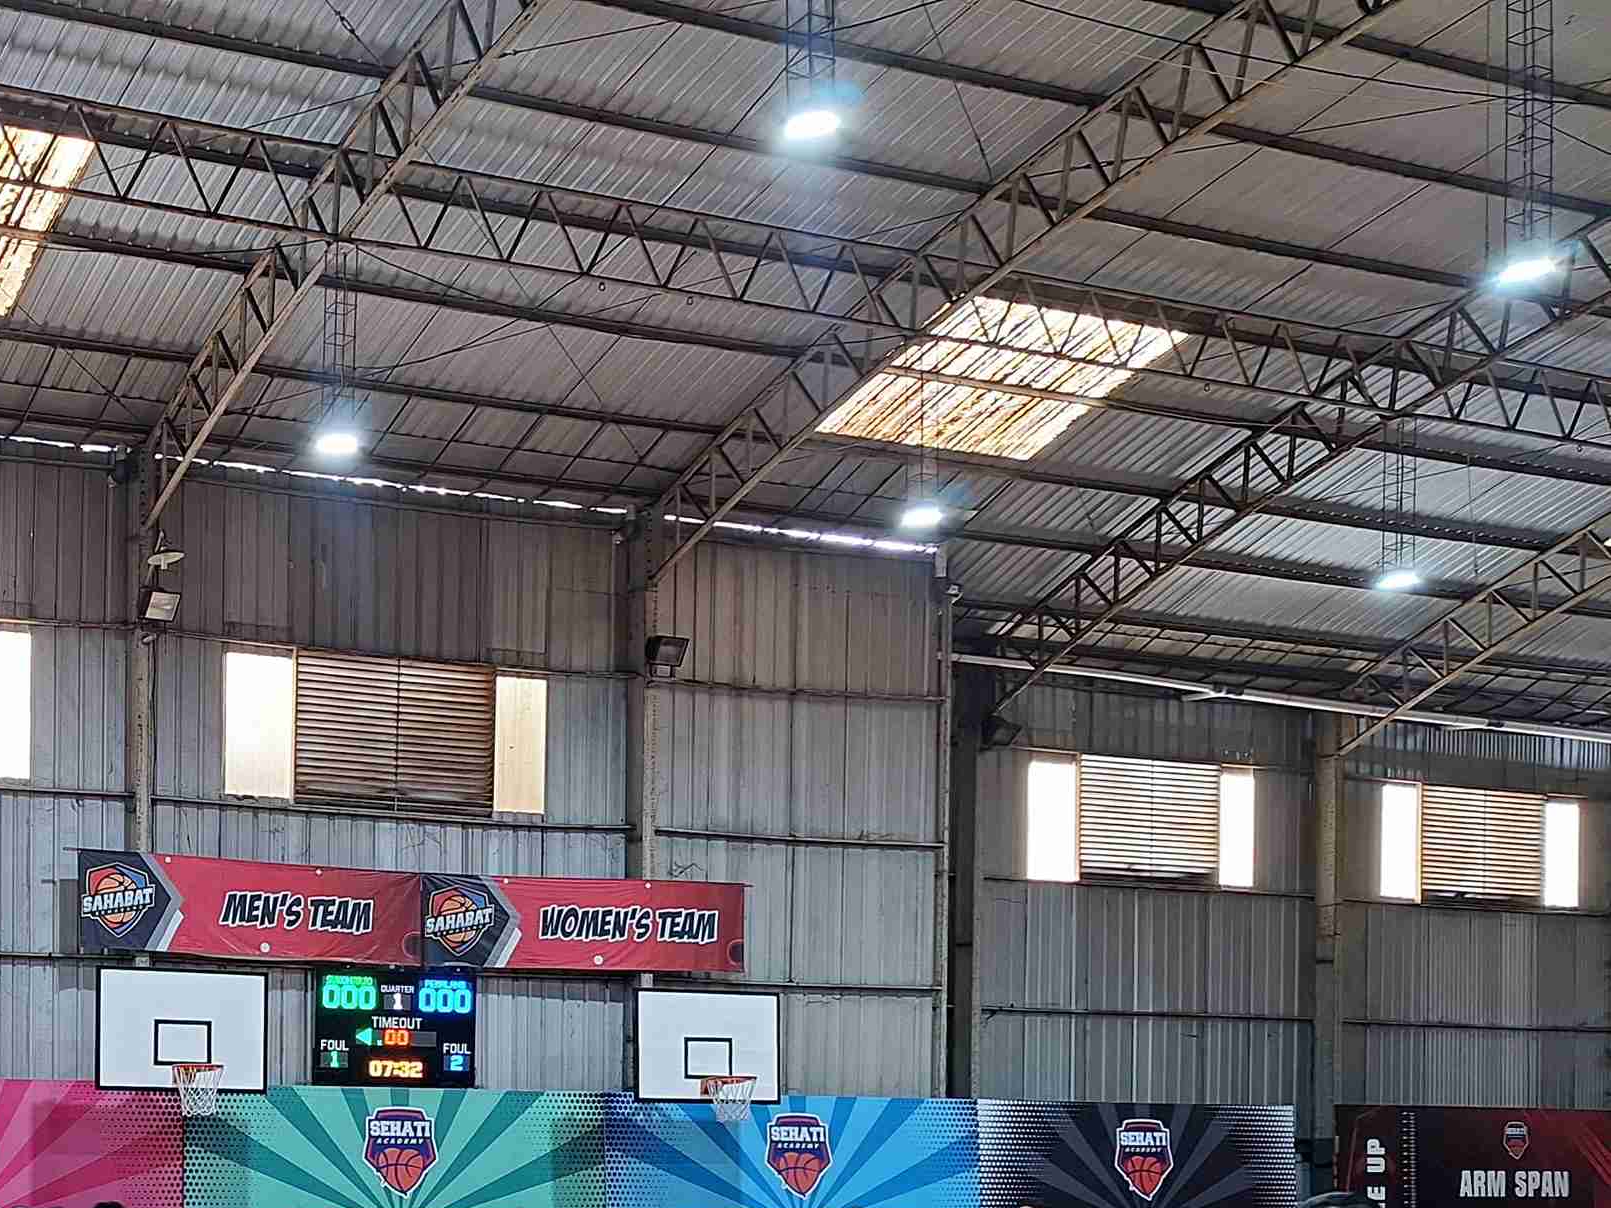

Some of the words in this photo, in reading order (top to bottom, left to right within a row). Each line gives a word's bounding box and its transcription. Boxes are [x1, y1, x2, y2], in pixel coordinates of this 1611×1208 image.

[83, 888, 153, 913] SAHABAT
[220, 892, 303, 928] MEN'S
[309, 897, 373, 935] TEAM
[426, 908, 492, 933] SAHABAT
[540, 905, 652, 942] WOMEN'S
[657, 908, 718, 945] TEAM
[322, 984, 376, 1010] 000
[380, 984, 414, 994] QUARTER
[393, 993, 403, 1010] 1
[419, 988, 471, 1013] 000
[372, 1016, 422, 1030] TIMEOUT
[320, 1039, 349, 1051] FOUL
[443, 1043, 471, 1054] FOUL
[330, 1051, 339, 1068] 1
[450, 1055, 464, 1071] 2
[369, 1060, 423, 1078] 07:32
[370, 1120, 430, 1137] SEHATI
[771, 1126, 826, 1142] SEHATI
[1121, 1132, 1166, 1146] SEHATI
[1367, 1138, 1386, 1173] UP
[1459, 1170, 1506, 1197] ARM
[1514, 1170, 1570, 1197] SPAN
